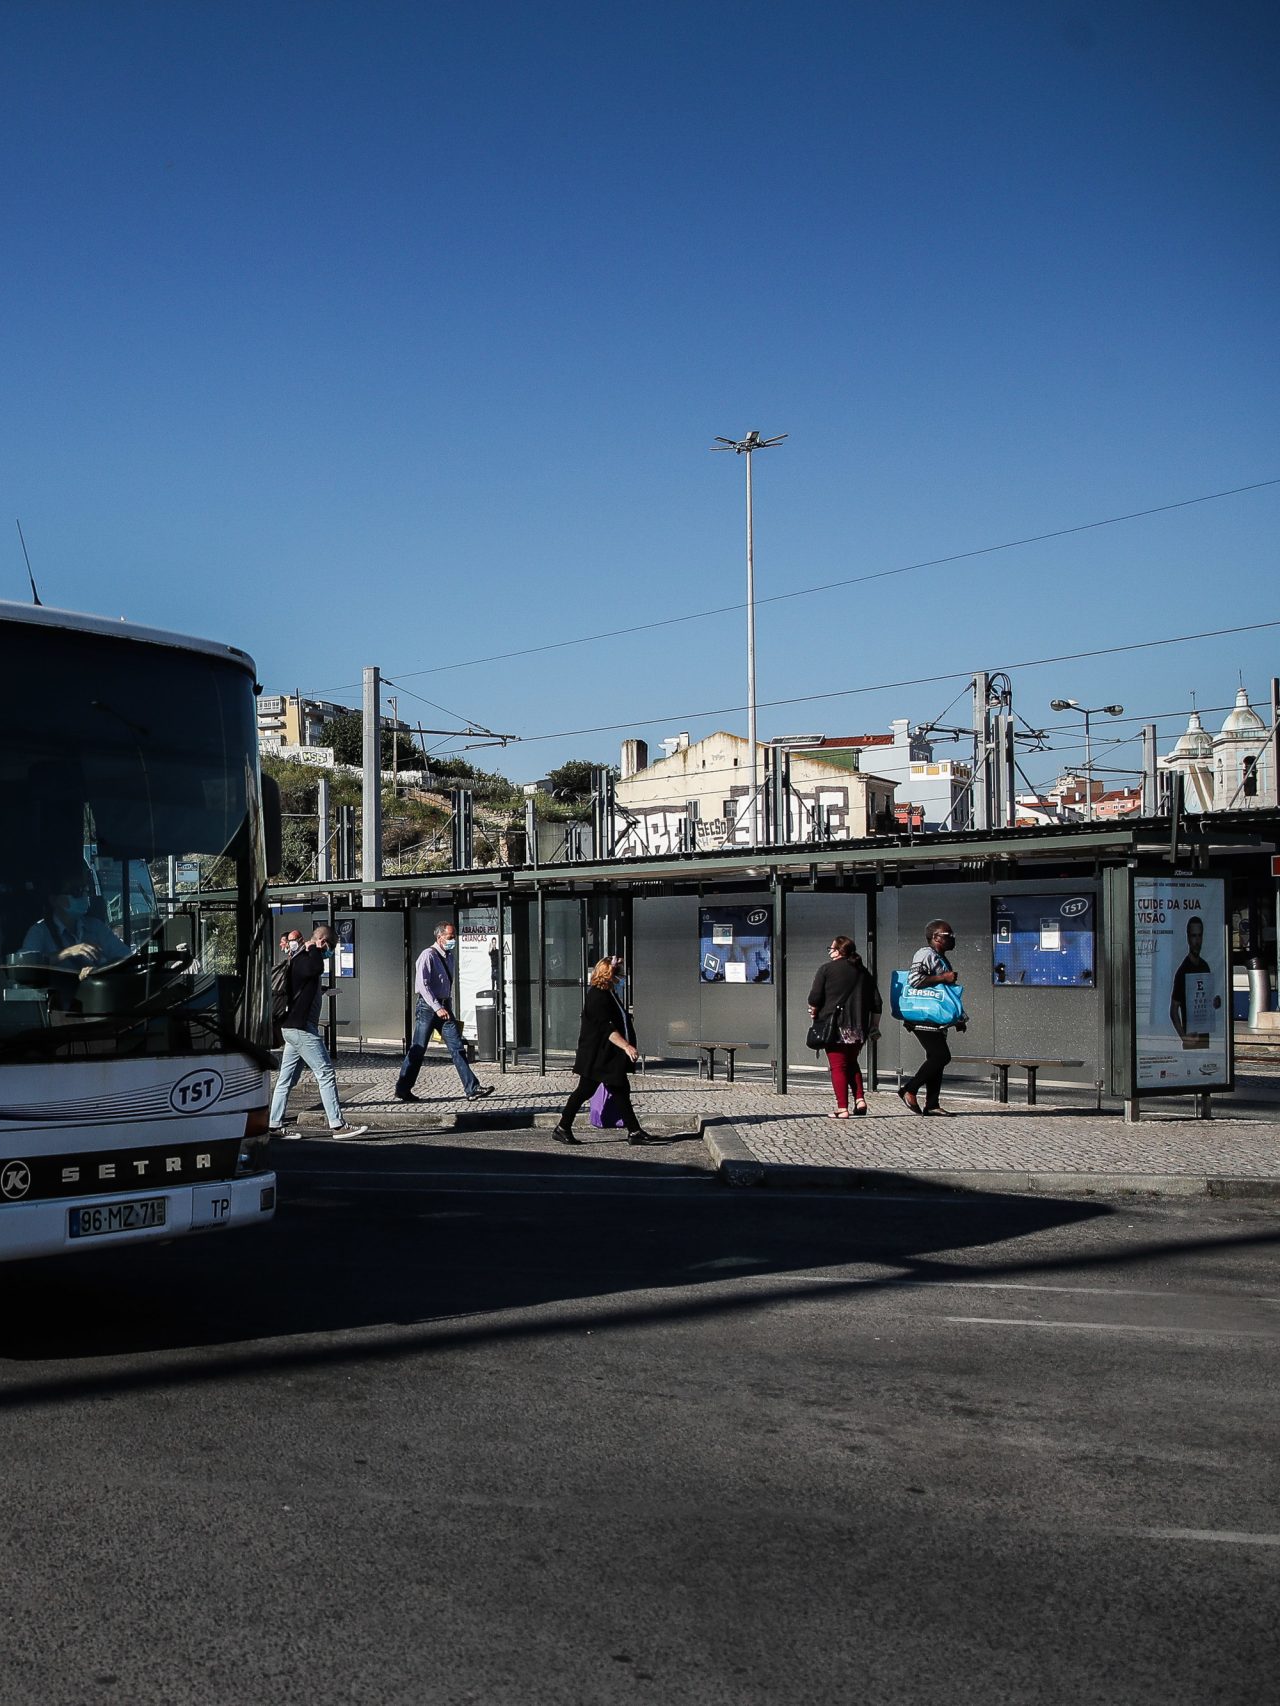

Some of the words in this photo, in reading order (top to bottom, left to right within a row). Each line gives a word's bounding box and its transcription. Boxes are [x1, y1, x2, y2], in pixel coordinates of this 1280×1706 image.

[1063, 902, 1085, 914] TST
[1137, 899, 1164, 910] CUIDE
[1167, 899, 1181, 910] DA
[1183, 899, 1202, 910] SUA
[750, 913, 764, 923] TST
[1137, 909, 1166, 923] VISÃO
[1000, 926, 1008, 937] 6
[907, 989, 941, 999] SEASIDE
[179, 1077, 215, 1106] TST
[61, 1153, 212, 1184] SETRA
[211, 1199, 229, 1218] TP
